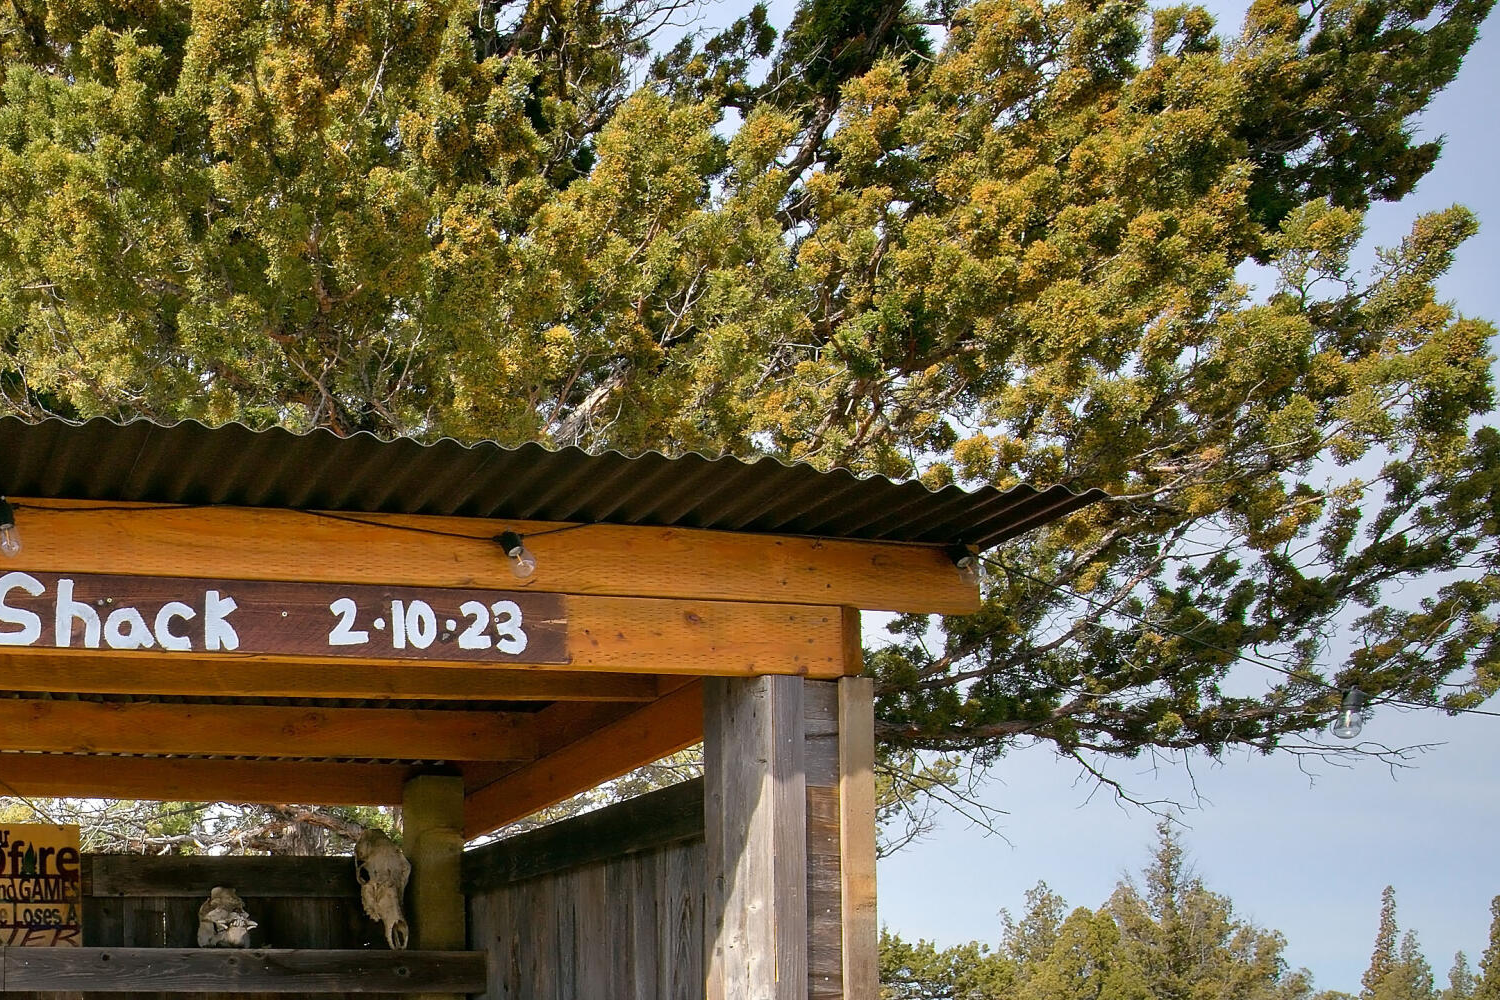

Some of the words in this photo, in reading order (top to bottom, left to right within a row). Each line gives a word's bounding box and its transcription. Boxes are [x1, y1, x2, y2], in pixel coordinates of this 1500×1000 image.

[19, 878, 79, 901] GAMES
[13, 903, 62, 926] Loses
[66, 903, 79, 926] A
